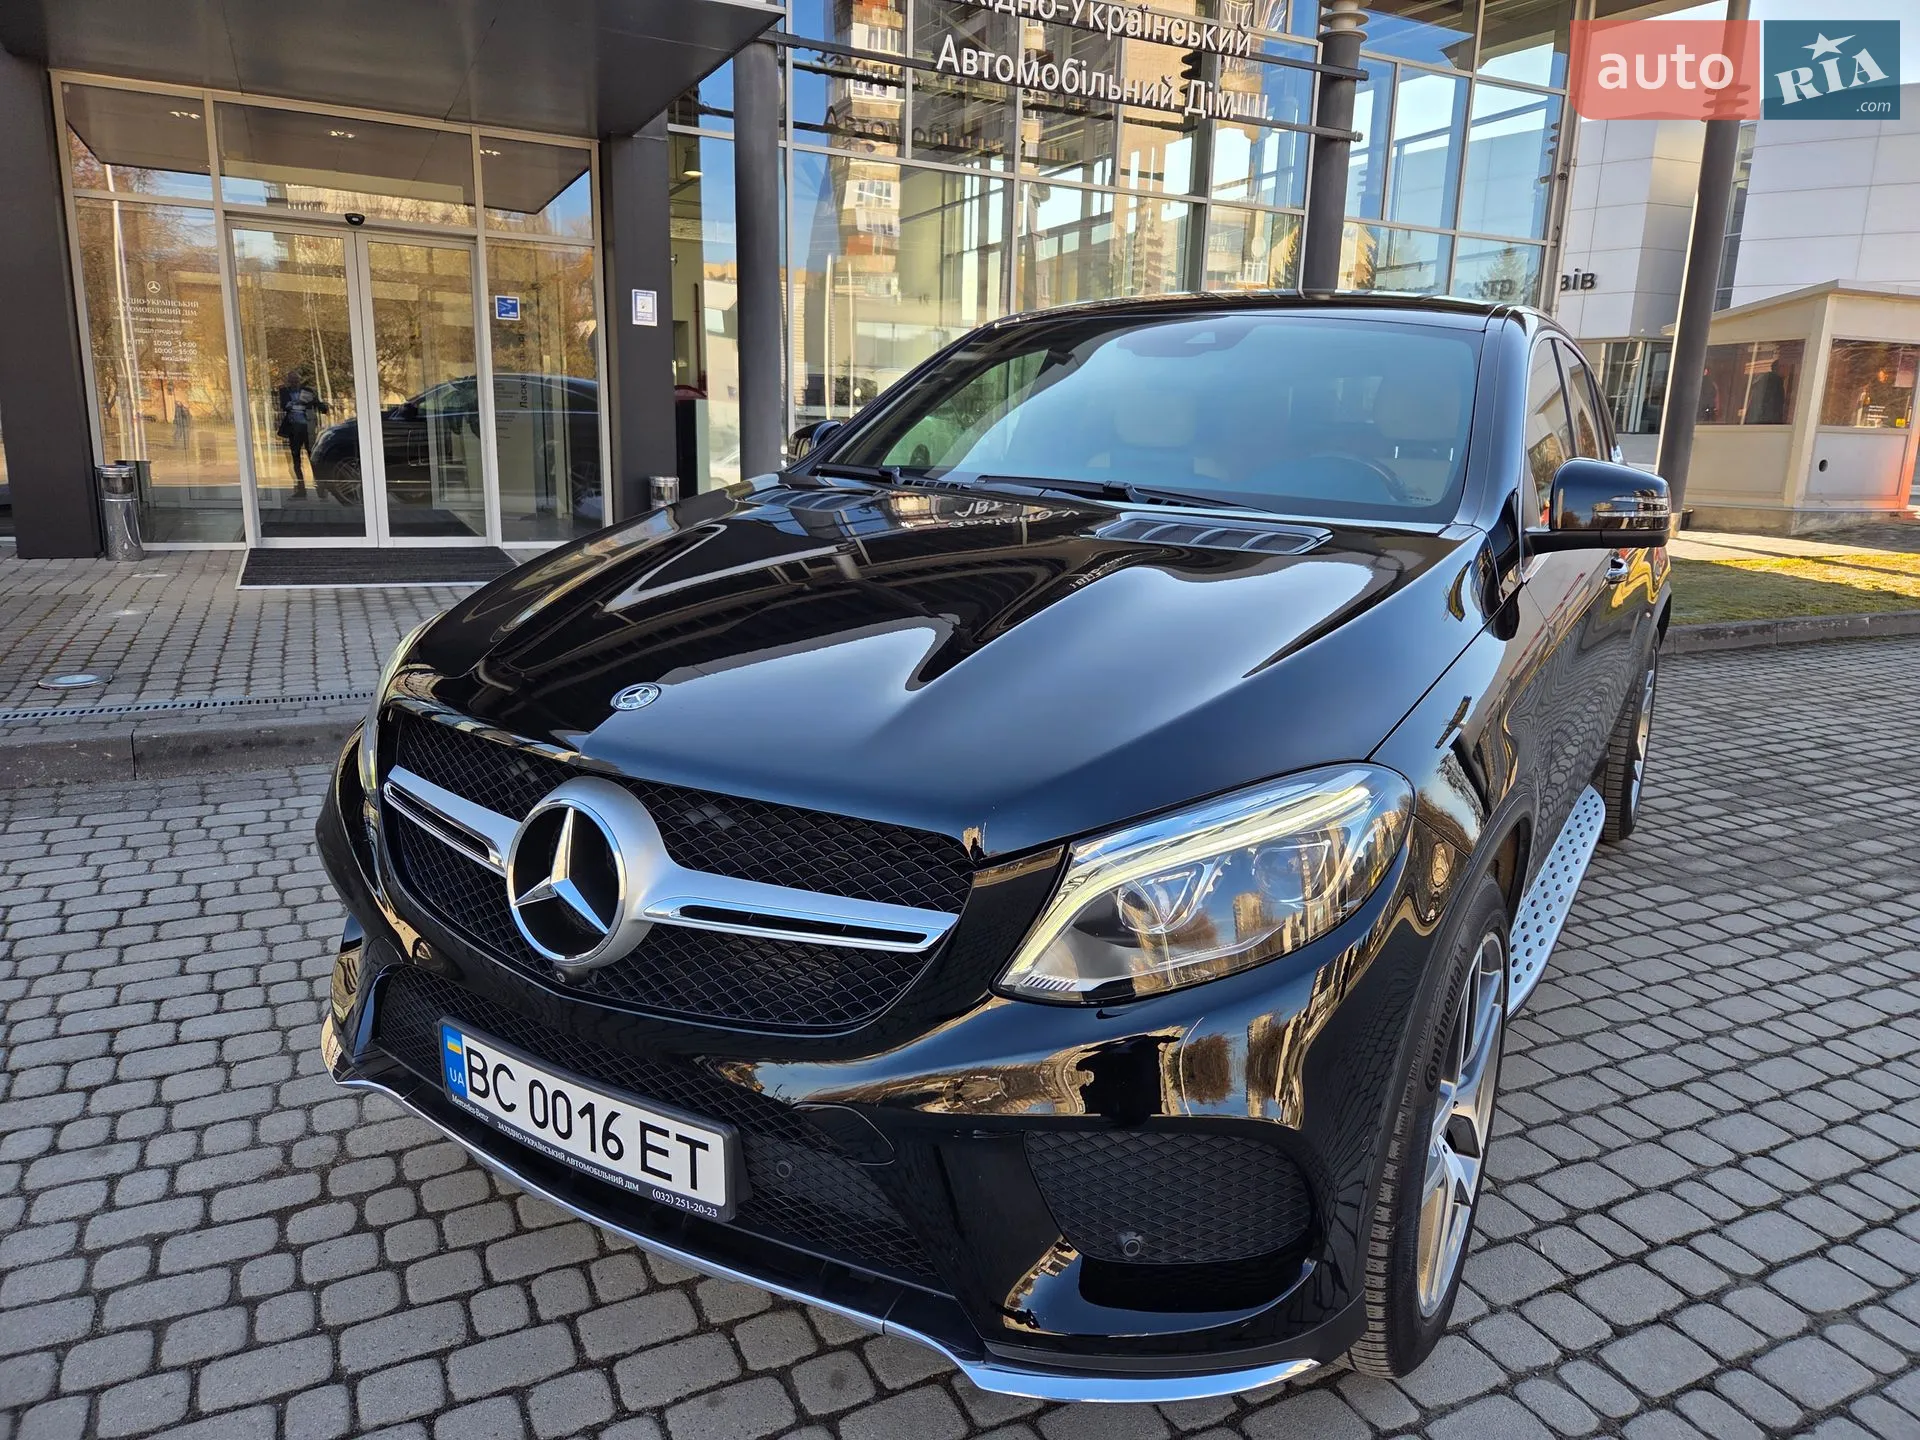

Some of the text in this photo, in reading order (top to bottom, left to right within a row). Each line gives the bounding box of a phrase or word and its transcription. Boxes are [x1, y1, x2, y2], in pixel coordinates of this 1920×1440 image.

[960, 0, 1252, 57] дно-Український
[936, 33, 1235, 119] Автомобільний Дім
[111, 296, 199, 308] ЗХДНО-УКРАЇНСЬКИЙ
[116, 305, 181, 316] АОМОБІЛЬНИЙ
[449, 1066, 465, 1088] UA
[465, 1045, 709, 1191] BC 0016 ET
[652, 1188, 674, 1205] (032)
[675, 1198, 717, 1218] 251-20-23
